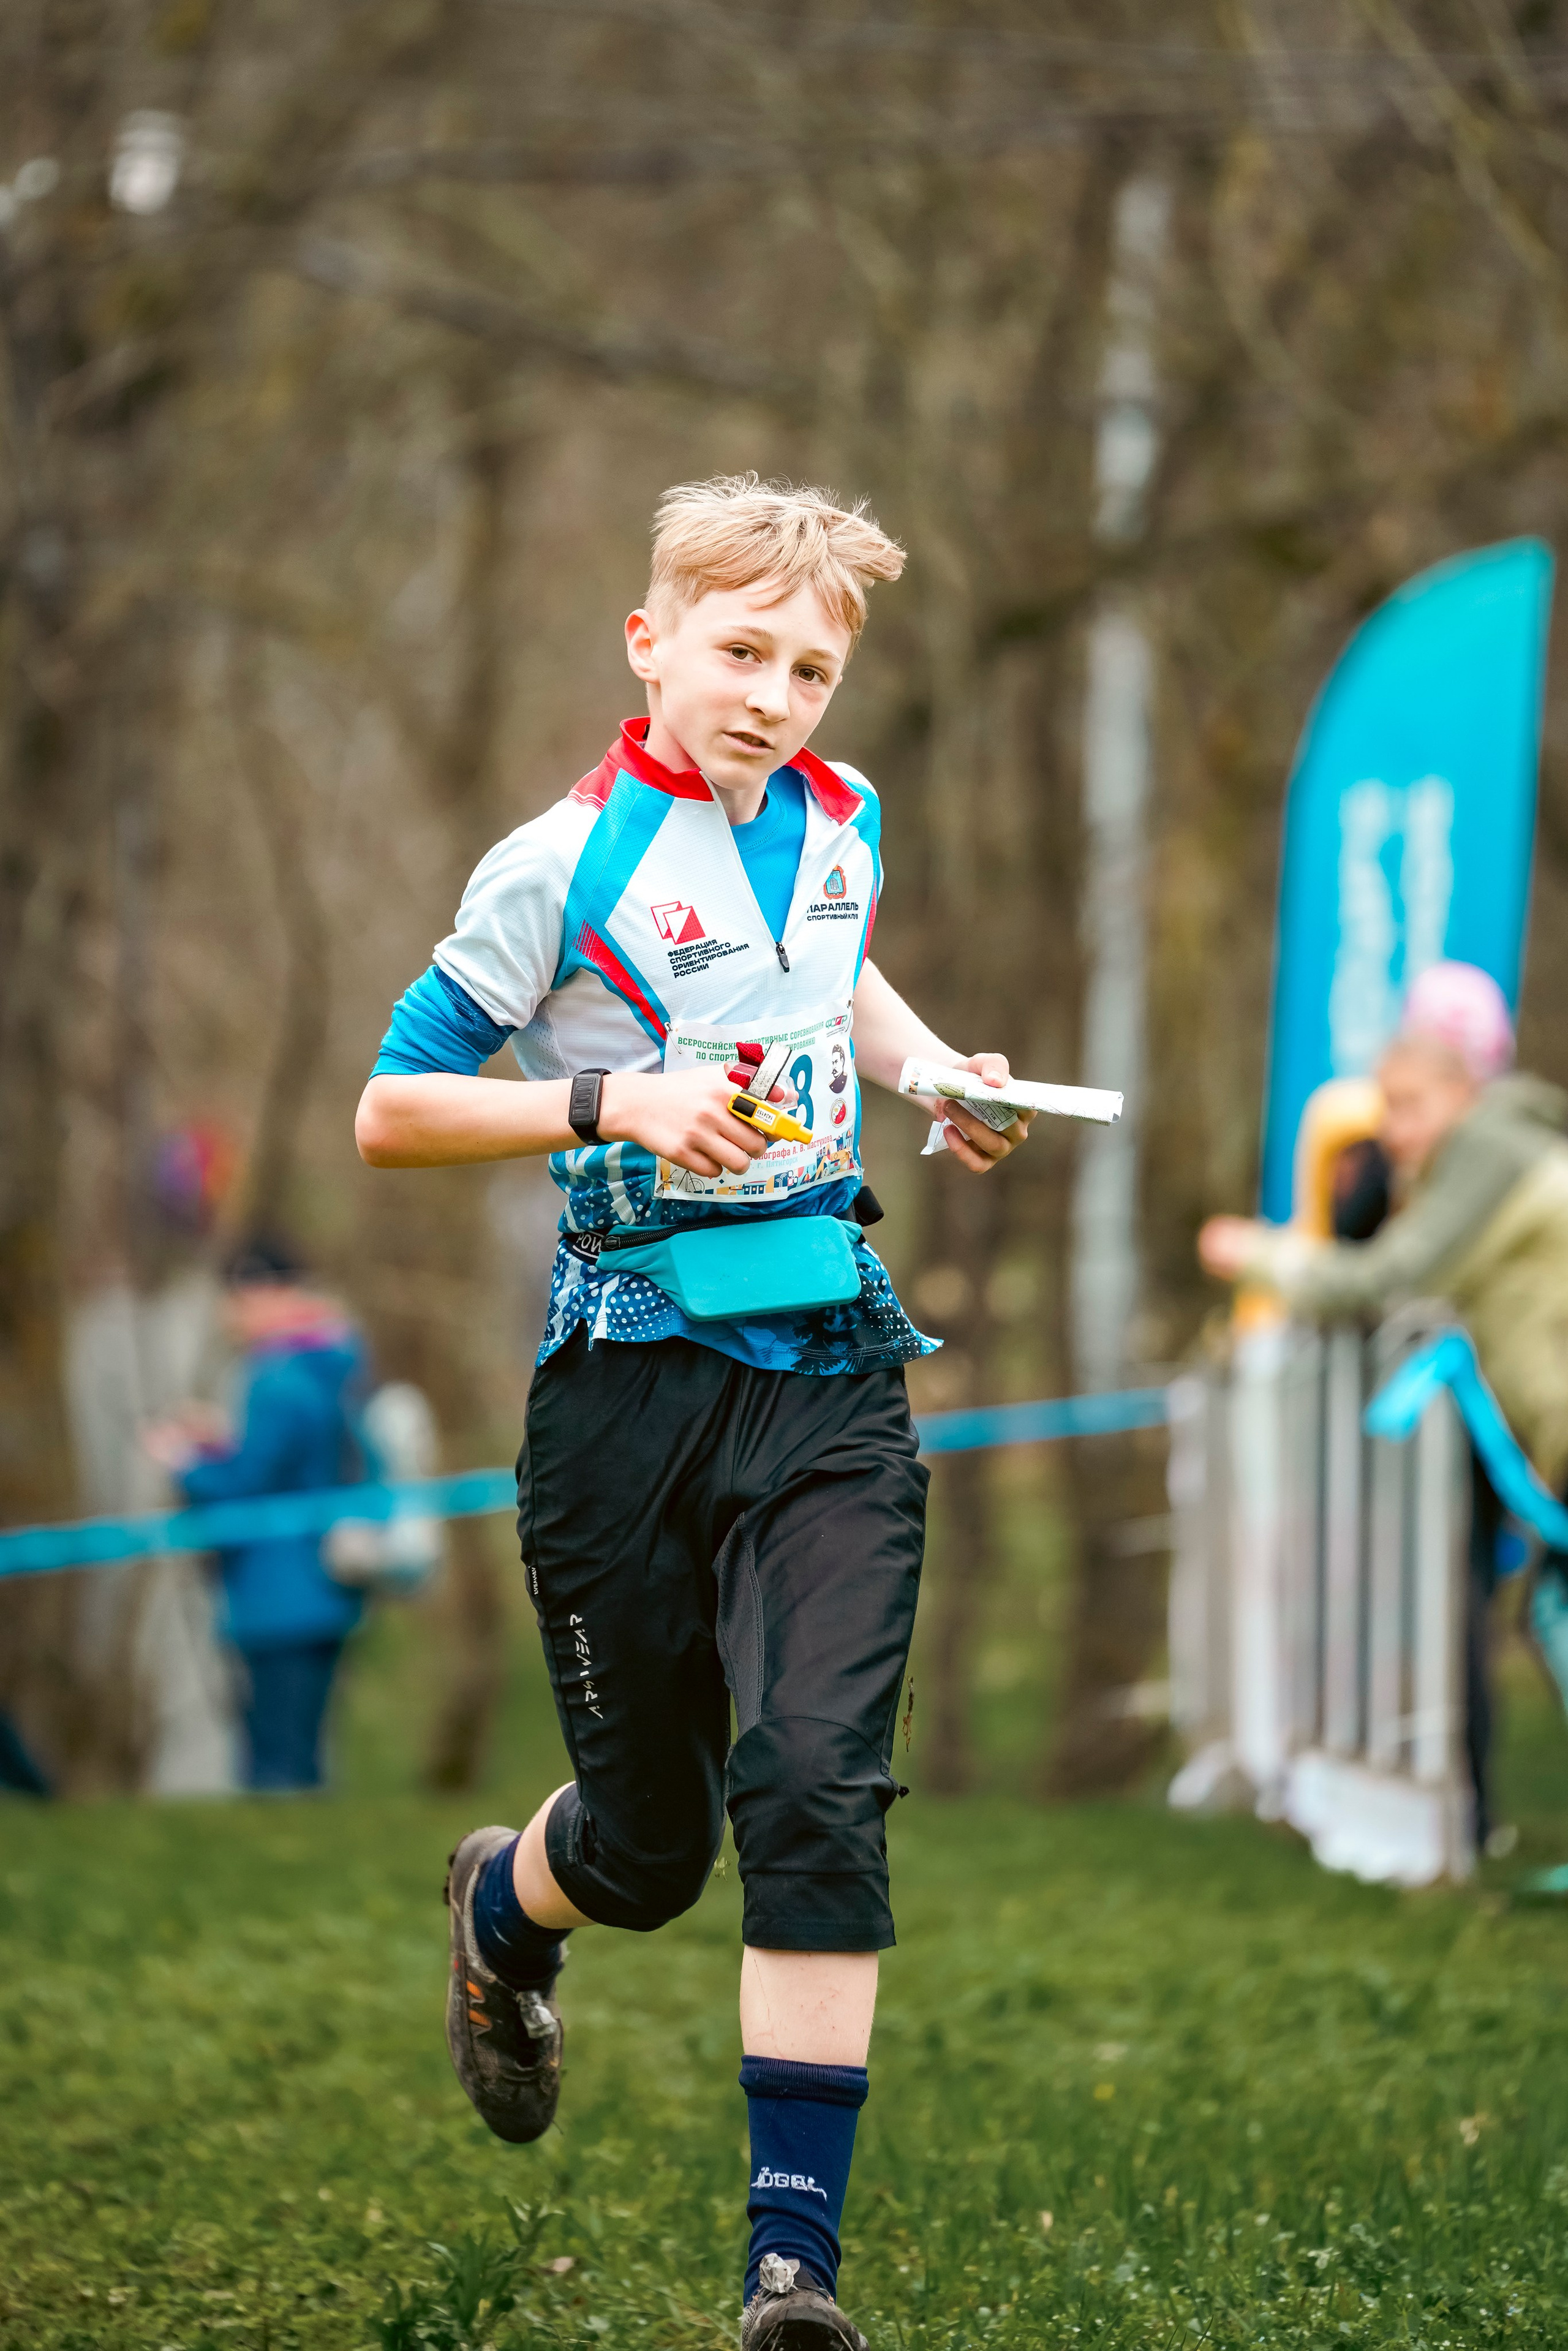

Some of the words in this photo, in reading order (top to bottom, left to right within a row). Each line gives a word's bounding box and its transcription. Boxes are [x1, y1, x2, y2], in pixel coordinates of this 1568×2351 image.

[807, 913, 848, 921] СПОРТИВНЫЙ
[668, 939, 718, 957] ФЕДЕРАЦИЯ
[669, 942, 731, 964] СПОРТИВНОГО
[672, 943, 750, 971] ОРИЕНТИРОВАНИЯ
[674, 963, 709, 978] РОССИИ
[790, 1021, 824, 1040] СОРЕВНОВАНИЯ
[696, 1051, 706, 1060] ПО
[788, 1054, 814, 1131] 8
[807, 1134, 832, 1150] Пастухова
[766, 1156, 798, 1168] Пятигорск
